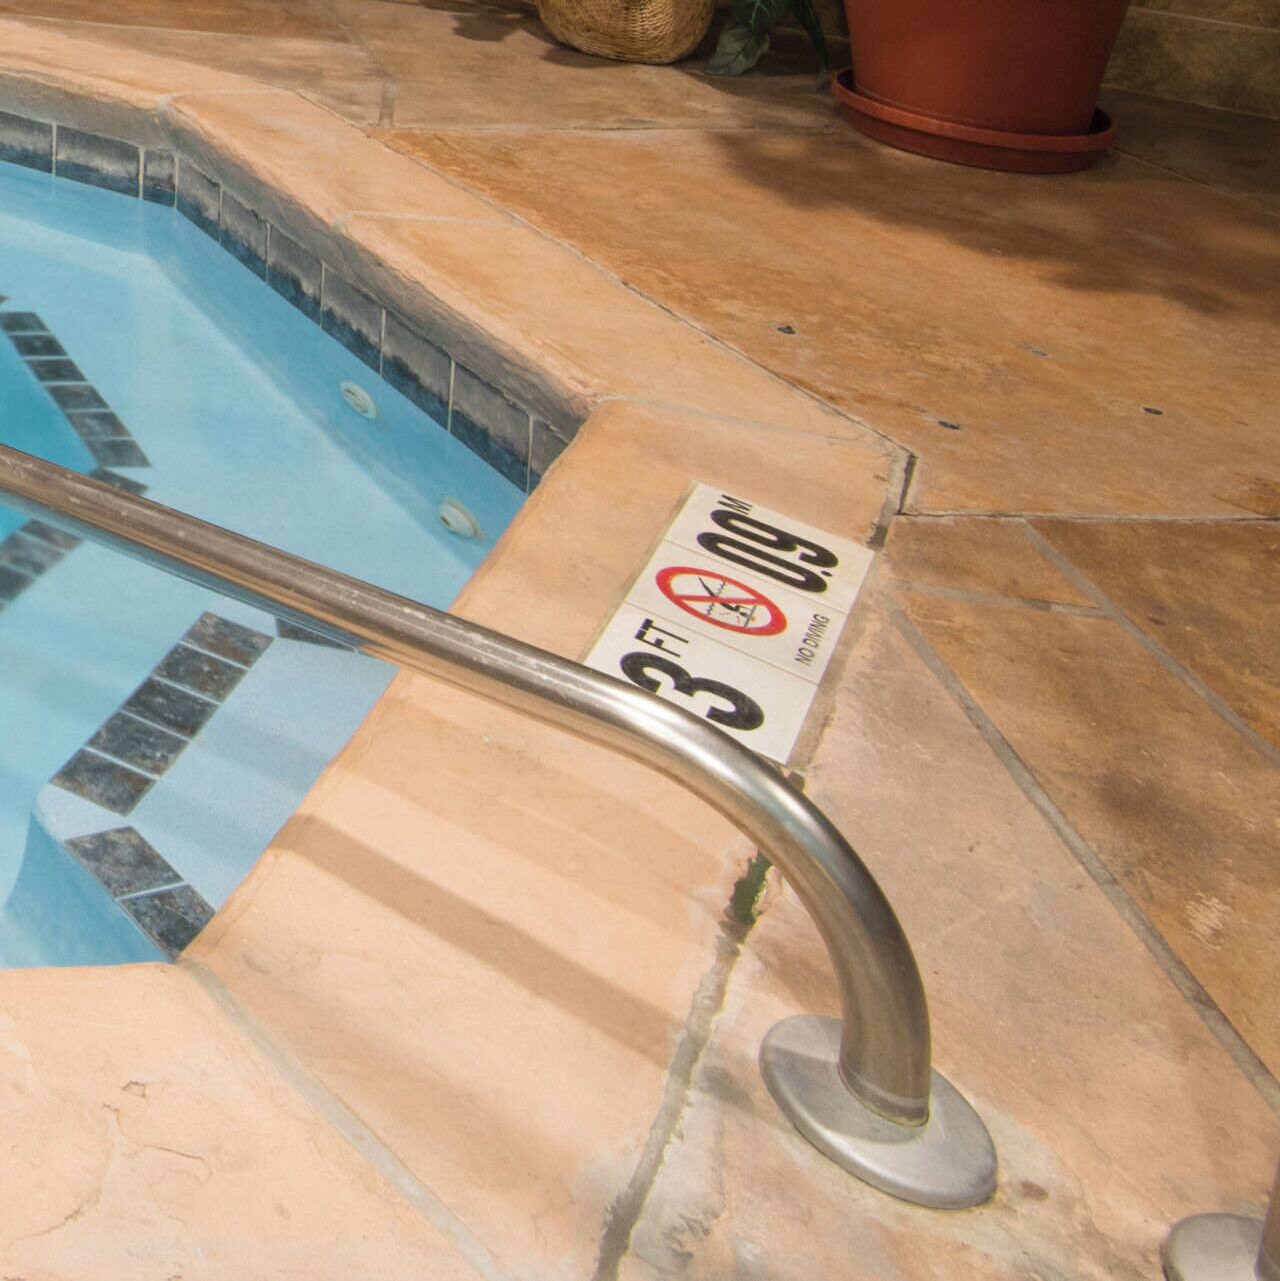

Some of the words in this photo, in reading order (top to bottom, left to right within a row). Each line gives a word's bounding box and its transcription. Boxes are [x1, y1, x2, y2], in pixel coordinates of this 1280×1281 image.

[718, 494, 752, 515] M
[696, 509, 838, 594] 0.9
[635, 618, 689, 658] FT
[794, 648, 816, 666] NO
[807, 614, 830, 648] DIVING
[620, 652, 764, 731] 3
